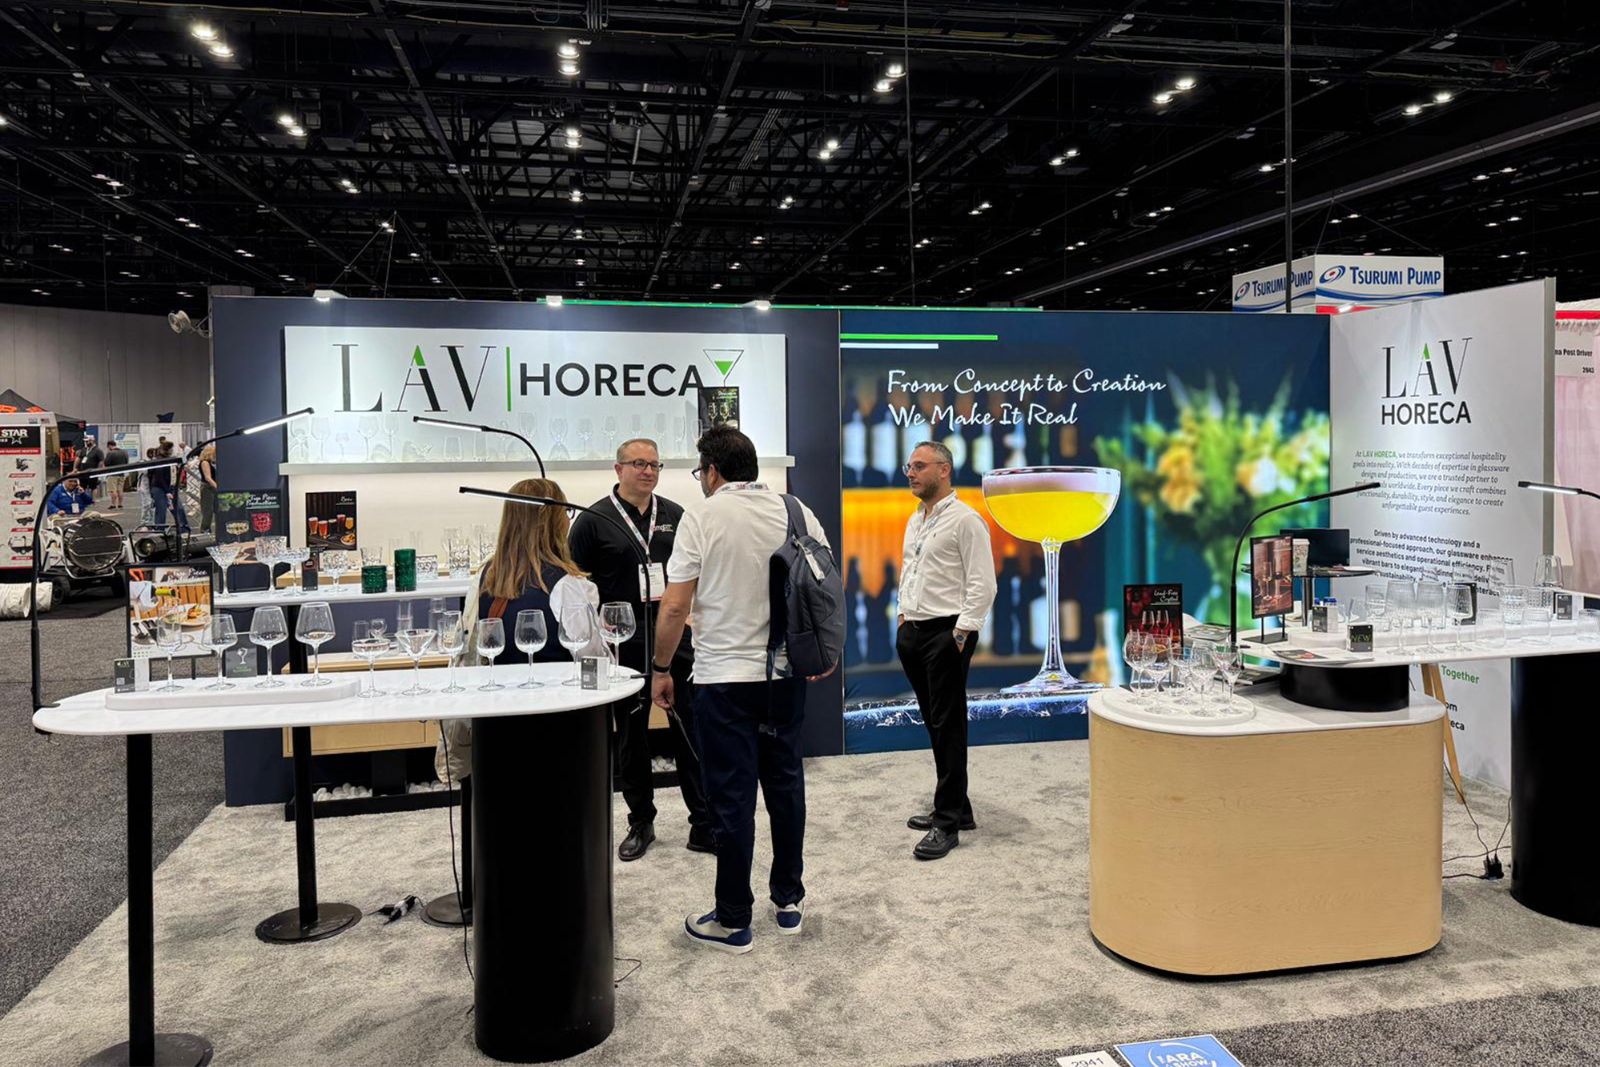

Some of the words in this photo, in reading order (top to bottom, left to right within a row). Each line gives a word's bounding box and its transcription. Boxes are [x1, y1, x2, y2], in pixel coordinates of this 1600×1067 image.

[1290, 270, 1313, 287] PUMP
[1349, 266, 1403, 285] TSURUMI
[1408, 267, 1441, 285] PUMP
[1381, 337, 1472, 399] LAV
[332, 344, 497, 413] LAV
[520, 362, 703, 397] HORECA
[888, 370, 949, 393] From
[954, 368, 1042, 401] Concept
[1047, 374, 1067, 390] to
[1072, 368, 1166, 393] Creation
[888, 403, 925, 428] We
[930, 402, 995, 431] Make
[1000, 403, 1022, 425] It
[1027, 402, 1078, 425] Real
[1382, 401, 1472, 425] HORECA
[1, 428, 28, 438] STAR
[1436, 452, 1470, 461] exceptional
[1472, 452, 1506, 462] hospitality
[1434, 462, 1441, 471] of
[1442, 463, 1469, 473] expertise
[1477, 464, 1509, 473] glassware
[1443, 474, 1464, 482] trusted
[1465, 475, 1489, 483] partner
[1417, 483, 1433, 492] Every
[1434, 484, 1448, 493] piece
[1459, 485, 1475, 495] craft
[1476, 486, 1507, 495] combines
[1418, 504, 1433, 513] guest
[1434, 506, 1470, 516] experiences.
[1448, 495, 1474, 505] elegance
[1483, 498, 1504, 506] create
[1374, 529, 1391, 538] Driven
[1400, 533, 1426, 542] advanced
[1428, 536, 1461, 548] technology
[1463, 539, 1475, 548] and
[1350, 538, 1405, 550] professional-focused
[1406, 543, 1435, 555] approach,
[1447, 549, 1479, 560] glassware
[1356, 548, 1375, 556] service
[1376, 551, 1404, 561] aesthetics
[1417, 556, 1450, 567] operational
[1362, 558, 1380, 567] vibrant
[1382, 560, 1393, 569] bars
[1441, 665, 1480, 684] Together
